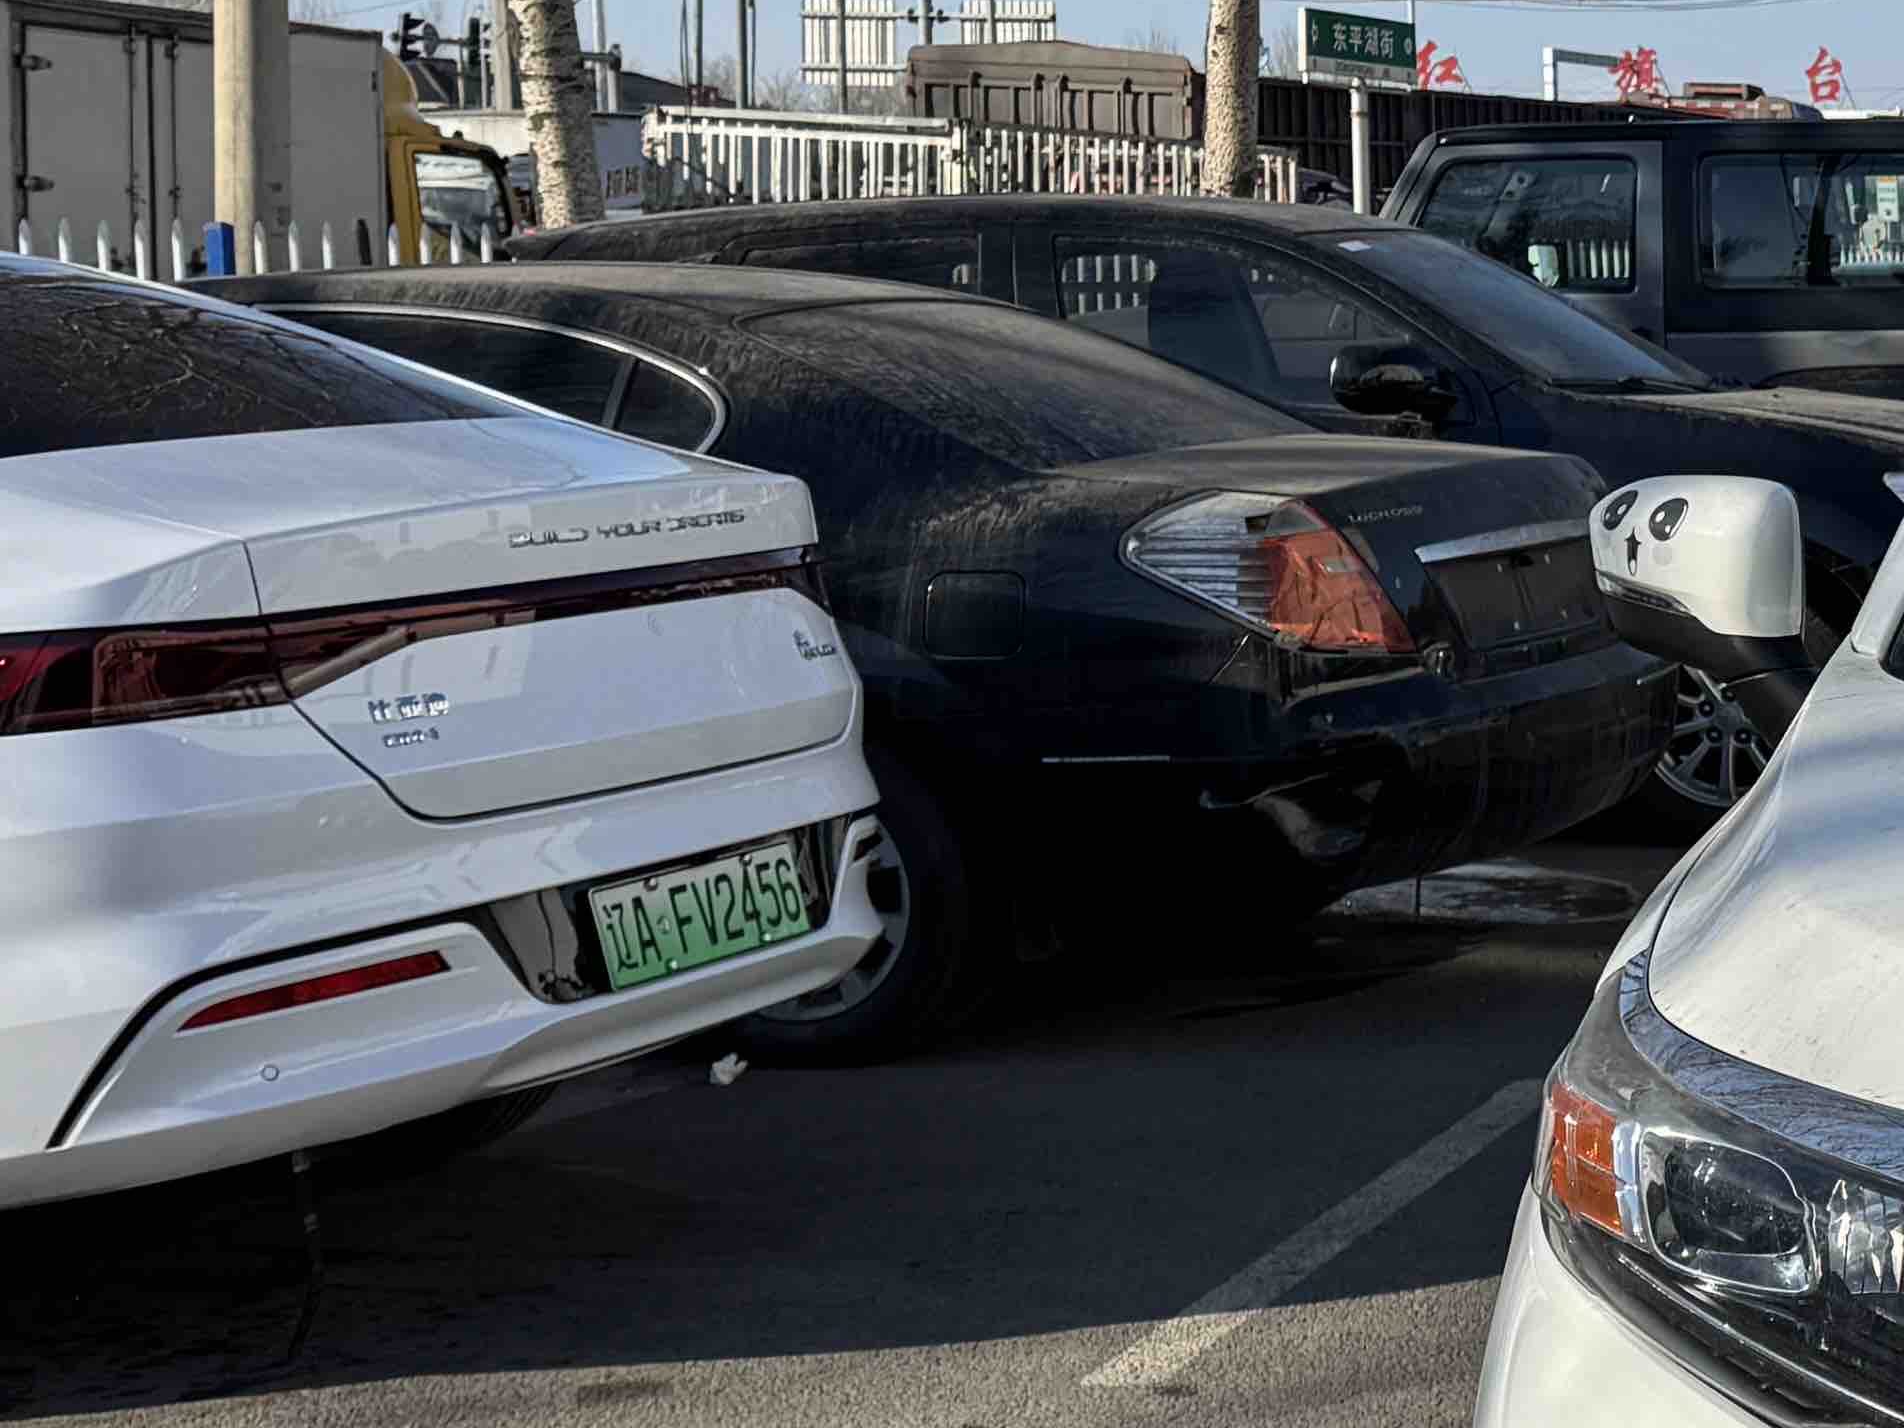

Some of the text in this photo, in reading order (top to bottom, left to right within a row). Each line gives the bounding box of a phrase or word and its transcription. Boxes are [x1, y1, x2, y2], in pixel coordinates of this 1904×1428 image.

[1331, 22, 1394, 59] 东平湖街
[597, 520, 660, 539] YOUR
